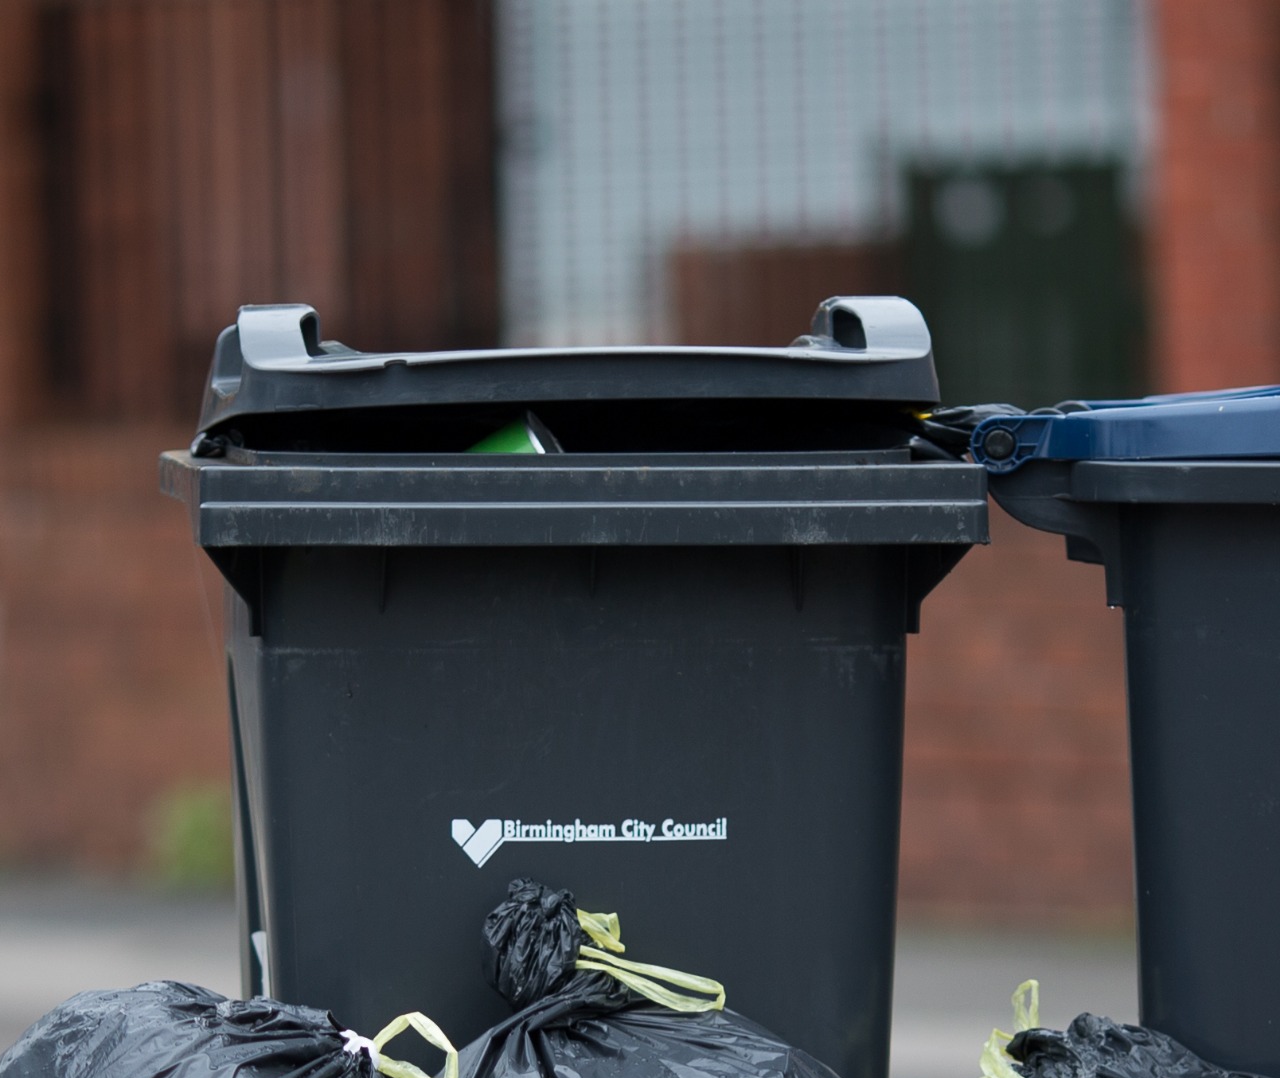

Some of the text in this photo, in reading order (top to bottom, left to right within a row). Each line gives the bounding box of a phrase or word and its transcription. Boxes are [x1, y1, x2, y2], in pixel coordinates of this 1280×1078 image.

[503, 817, 728, 842] Birmingham City Council
